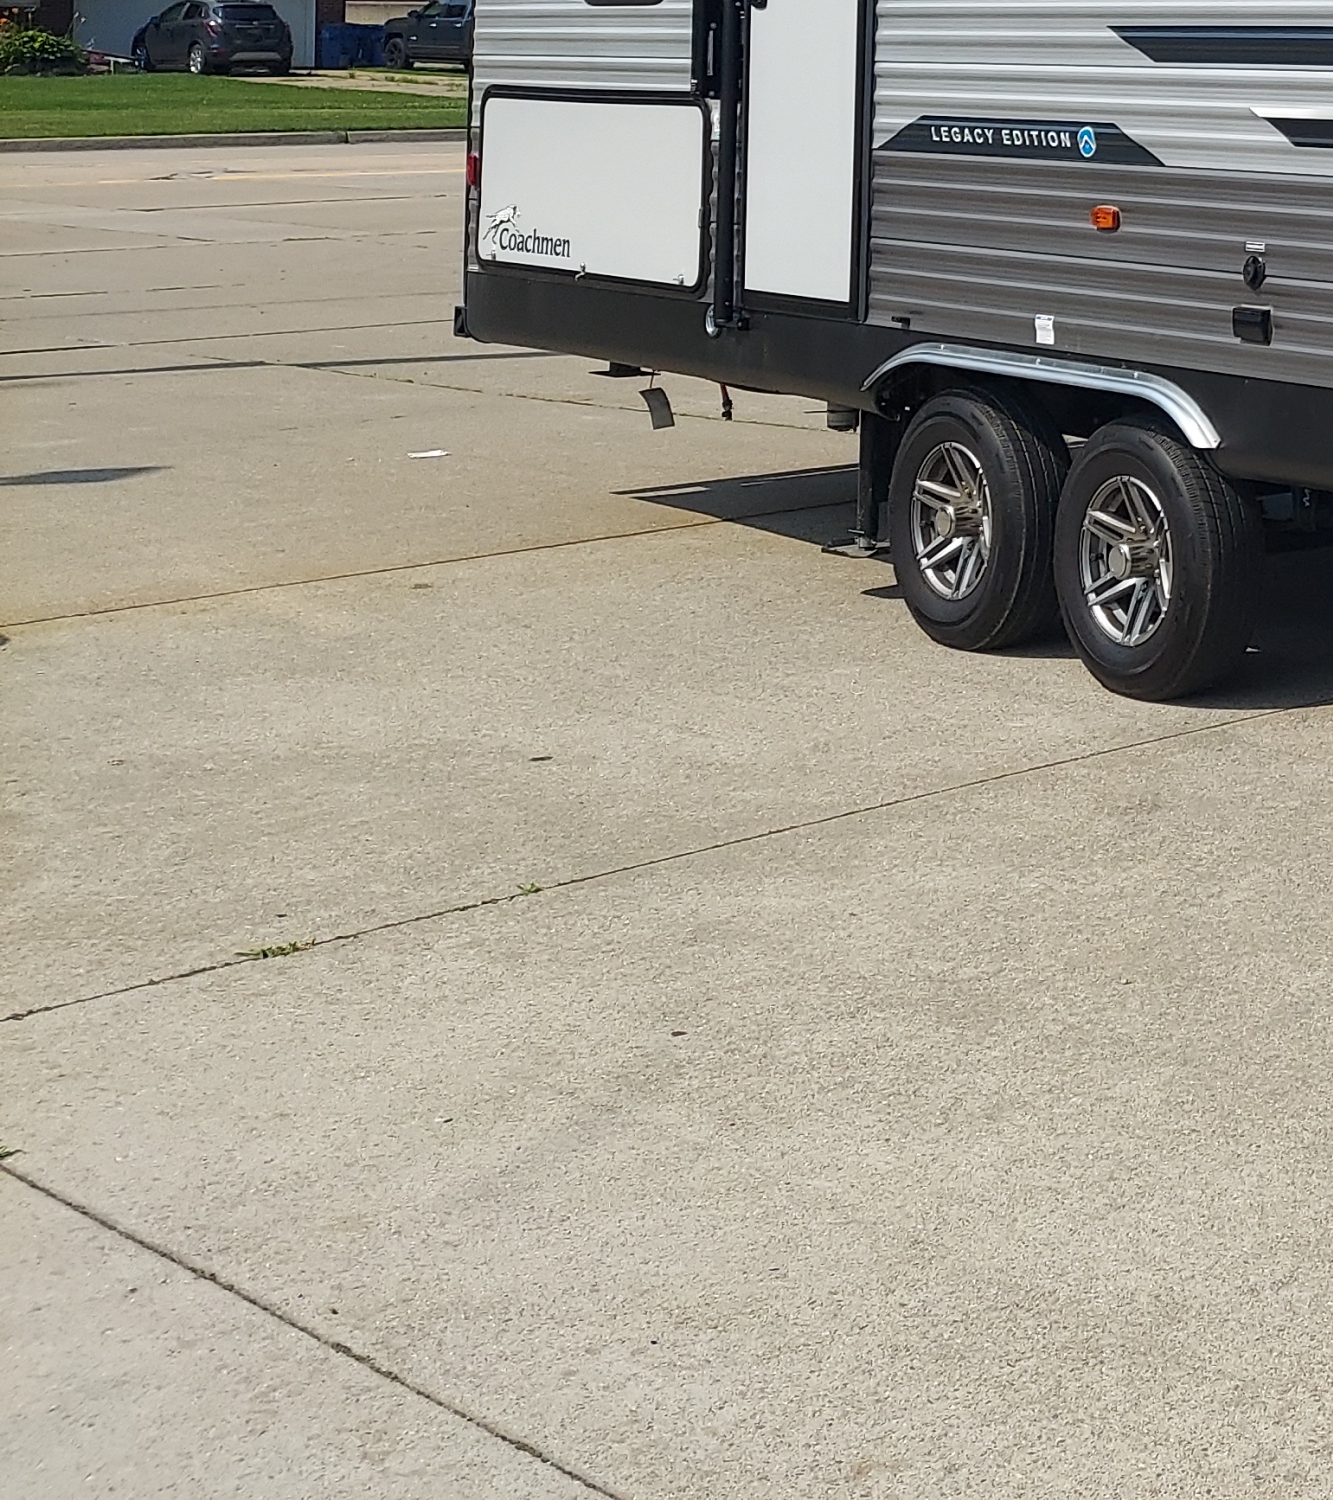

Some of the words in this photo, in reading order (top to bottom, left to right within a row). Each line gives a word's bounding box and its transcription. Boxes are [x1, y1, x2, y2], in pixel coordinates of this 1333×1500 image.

[930, 126, 994, 145] LEGACY
[1001, 129, 1072, 148] EDITION
[499, 228, 571, 258] Coachmen
